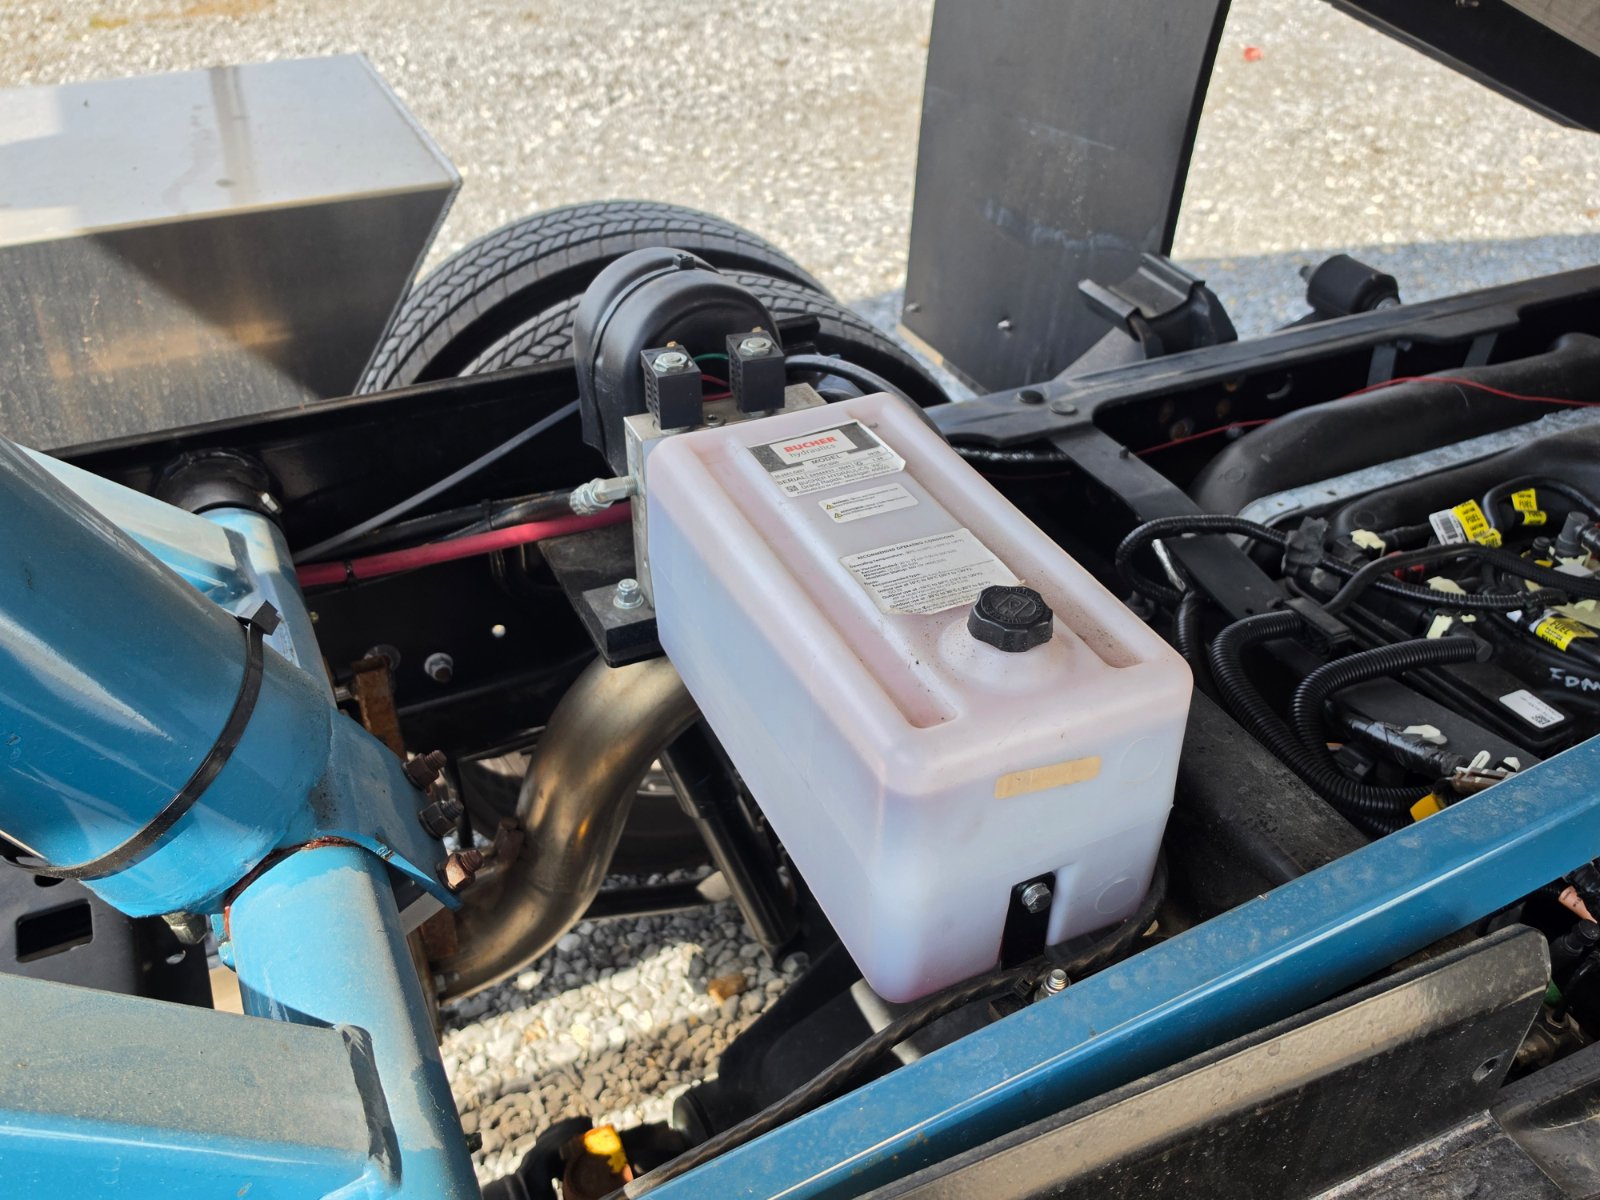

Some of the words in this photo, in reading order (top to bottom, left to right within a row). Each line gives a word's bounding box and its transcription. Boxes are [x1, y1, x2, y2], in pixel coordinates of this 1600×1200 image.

[783, 436, 837, 453] BUCHER
[789, 443, 837, 459] hydraulics
[811, 454, 840, 464] MODEL
[777, 476, 806, 485] SERIAL
[1518, 500, 1533, 508] FUEL
[1465, 513, 1480, 523] FUEL
[1549, 621, 1570, 635] FUEL
